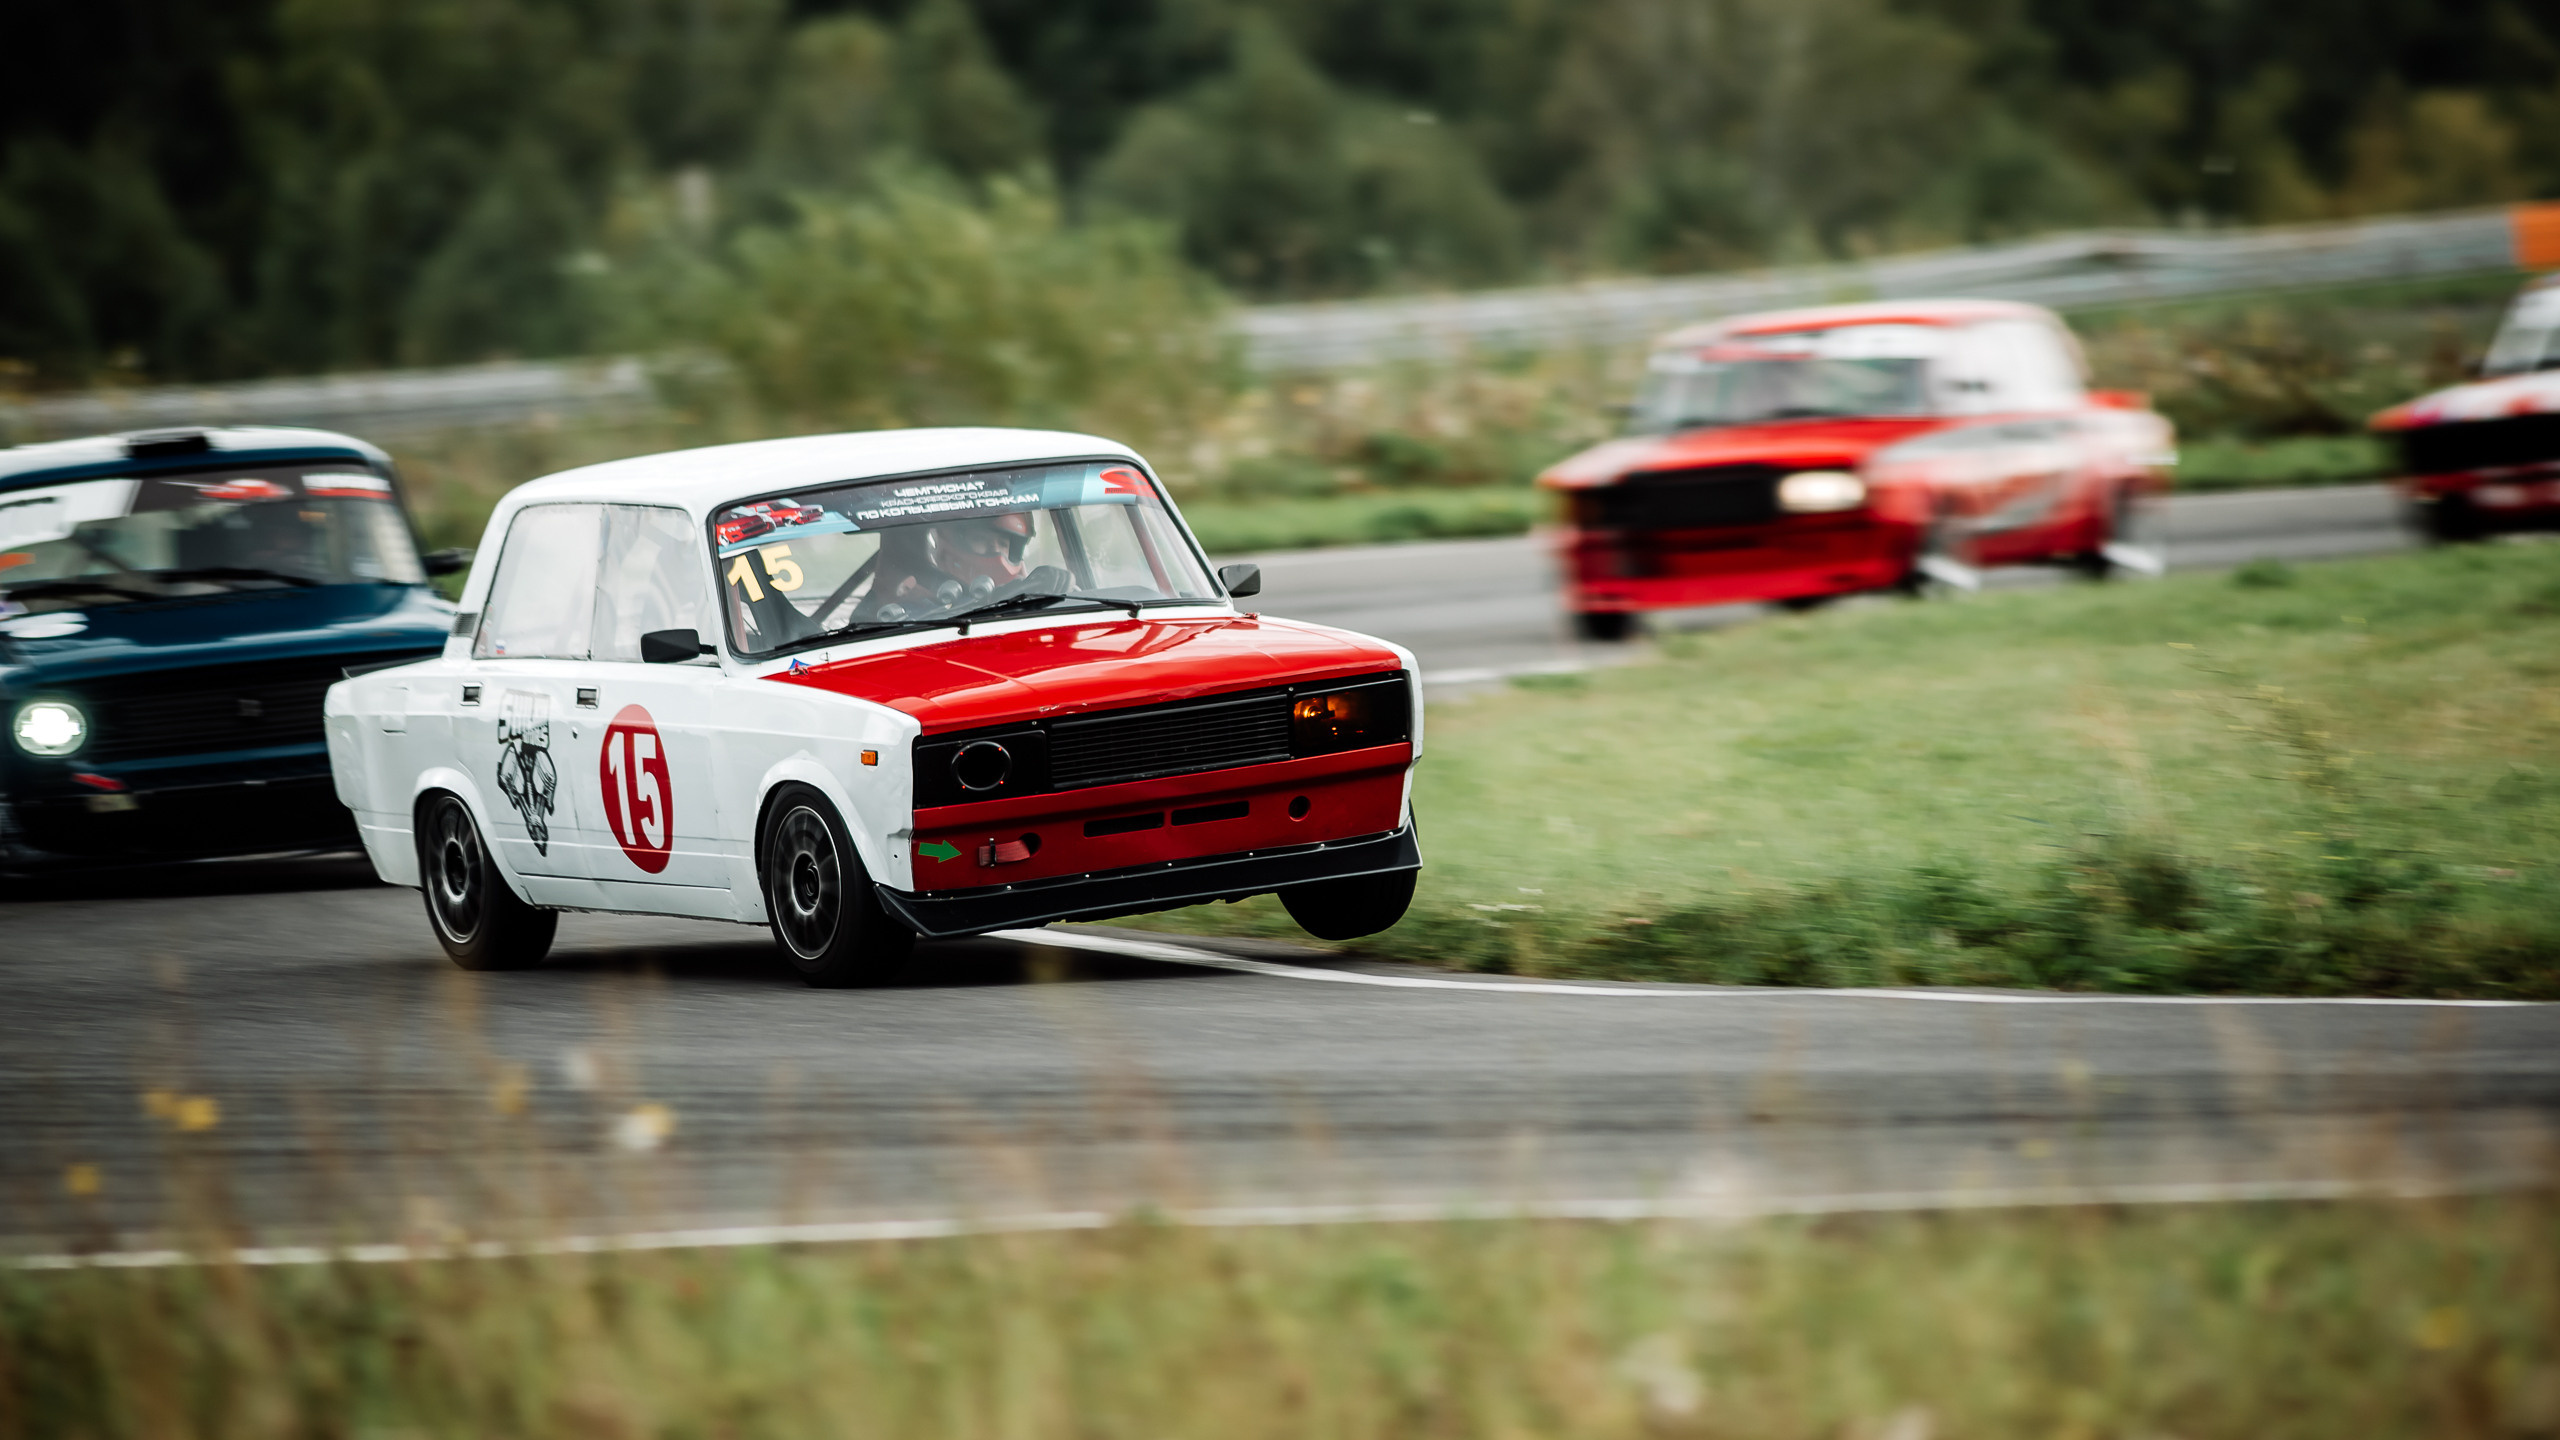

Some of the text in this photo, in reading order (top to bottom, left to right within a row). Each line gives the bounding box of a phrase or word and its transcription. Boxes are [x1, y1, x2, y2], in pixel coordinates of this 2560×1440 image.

[894, 481, 985, 497] ЧЕМПИОНАТ
[978, 489, 1009, 498] КРАЯ
[857, 493, 1040, 521] ПО КОЛЬЦЕВЫМ ГОНКАМ
[727, 544, 804, 603] 15
[608, 731, 665, 849] 15
